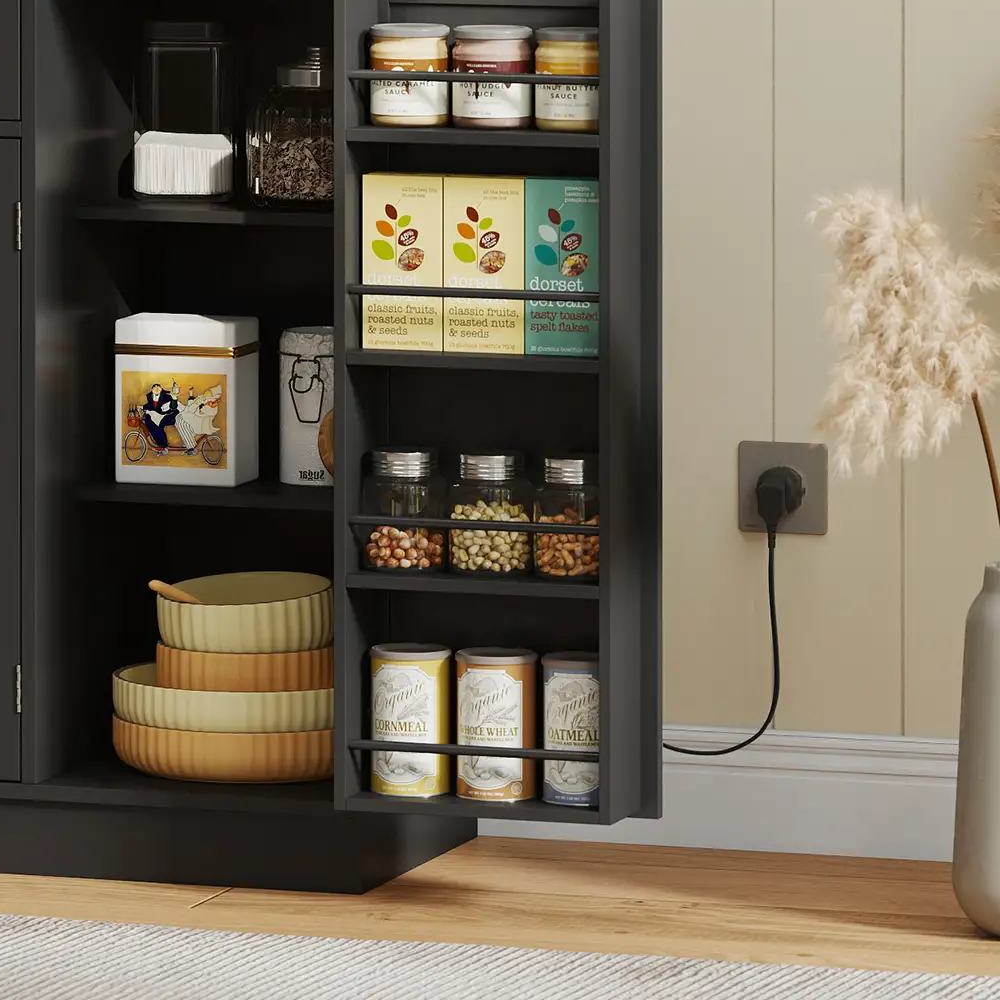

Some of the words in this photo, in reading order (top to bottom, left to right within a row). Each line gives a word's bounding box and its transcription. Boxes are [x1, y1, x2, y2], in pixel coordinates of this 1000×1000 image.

[367, 272, 418, 286] dorset
[449, 274, 502, 288] dorset
[529, 276, 584, 292] dorset
[367, 304, 403, 313] classic
[406, 305, 438, 315] fruits,
[448, 306, 485, 316] classic
[487, 308, 519, 318] fruits,
[368, 316, 407, 325] roasted
[409, 317, 434, 325] nuts
[530, 310, 557, 322] tasty
[449, 318, 488, 328] roasted
[491, 320, 516, 329] nuts
[530, 322, 556, 333] spelt
[558, 322, 590, 333] flakes
[367, 325, 377, 334] &
[379, 326, 408, 335] seeds
[449, 328, 458, 337] &
[460, 329, 490, 338] seeds
[374, 679, 425, 718] Organic
[460, 683, 509, 721] Organic
[547, 687, 598, 727] Organic
[374, 719, 429, 732] CORNMEAL
[486, 727, 519, 737] WHEAT
[547, 727, 599, 741] OATMEAL
